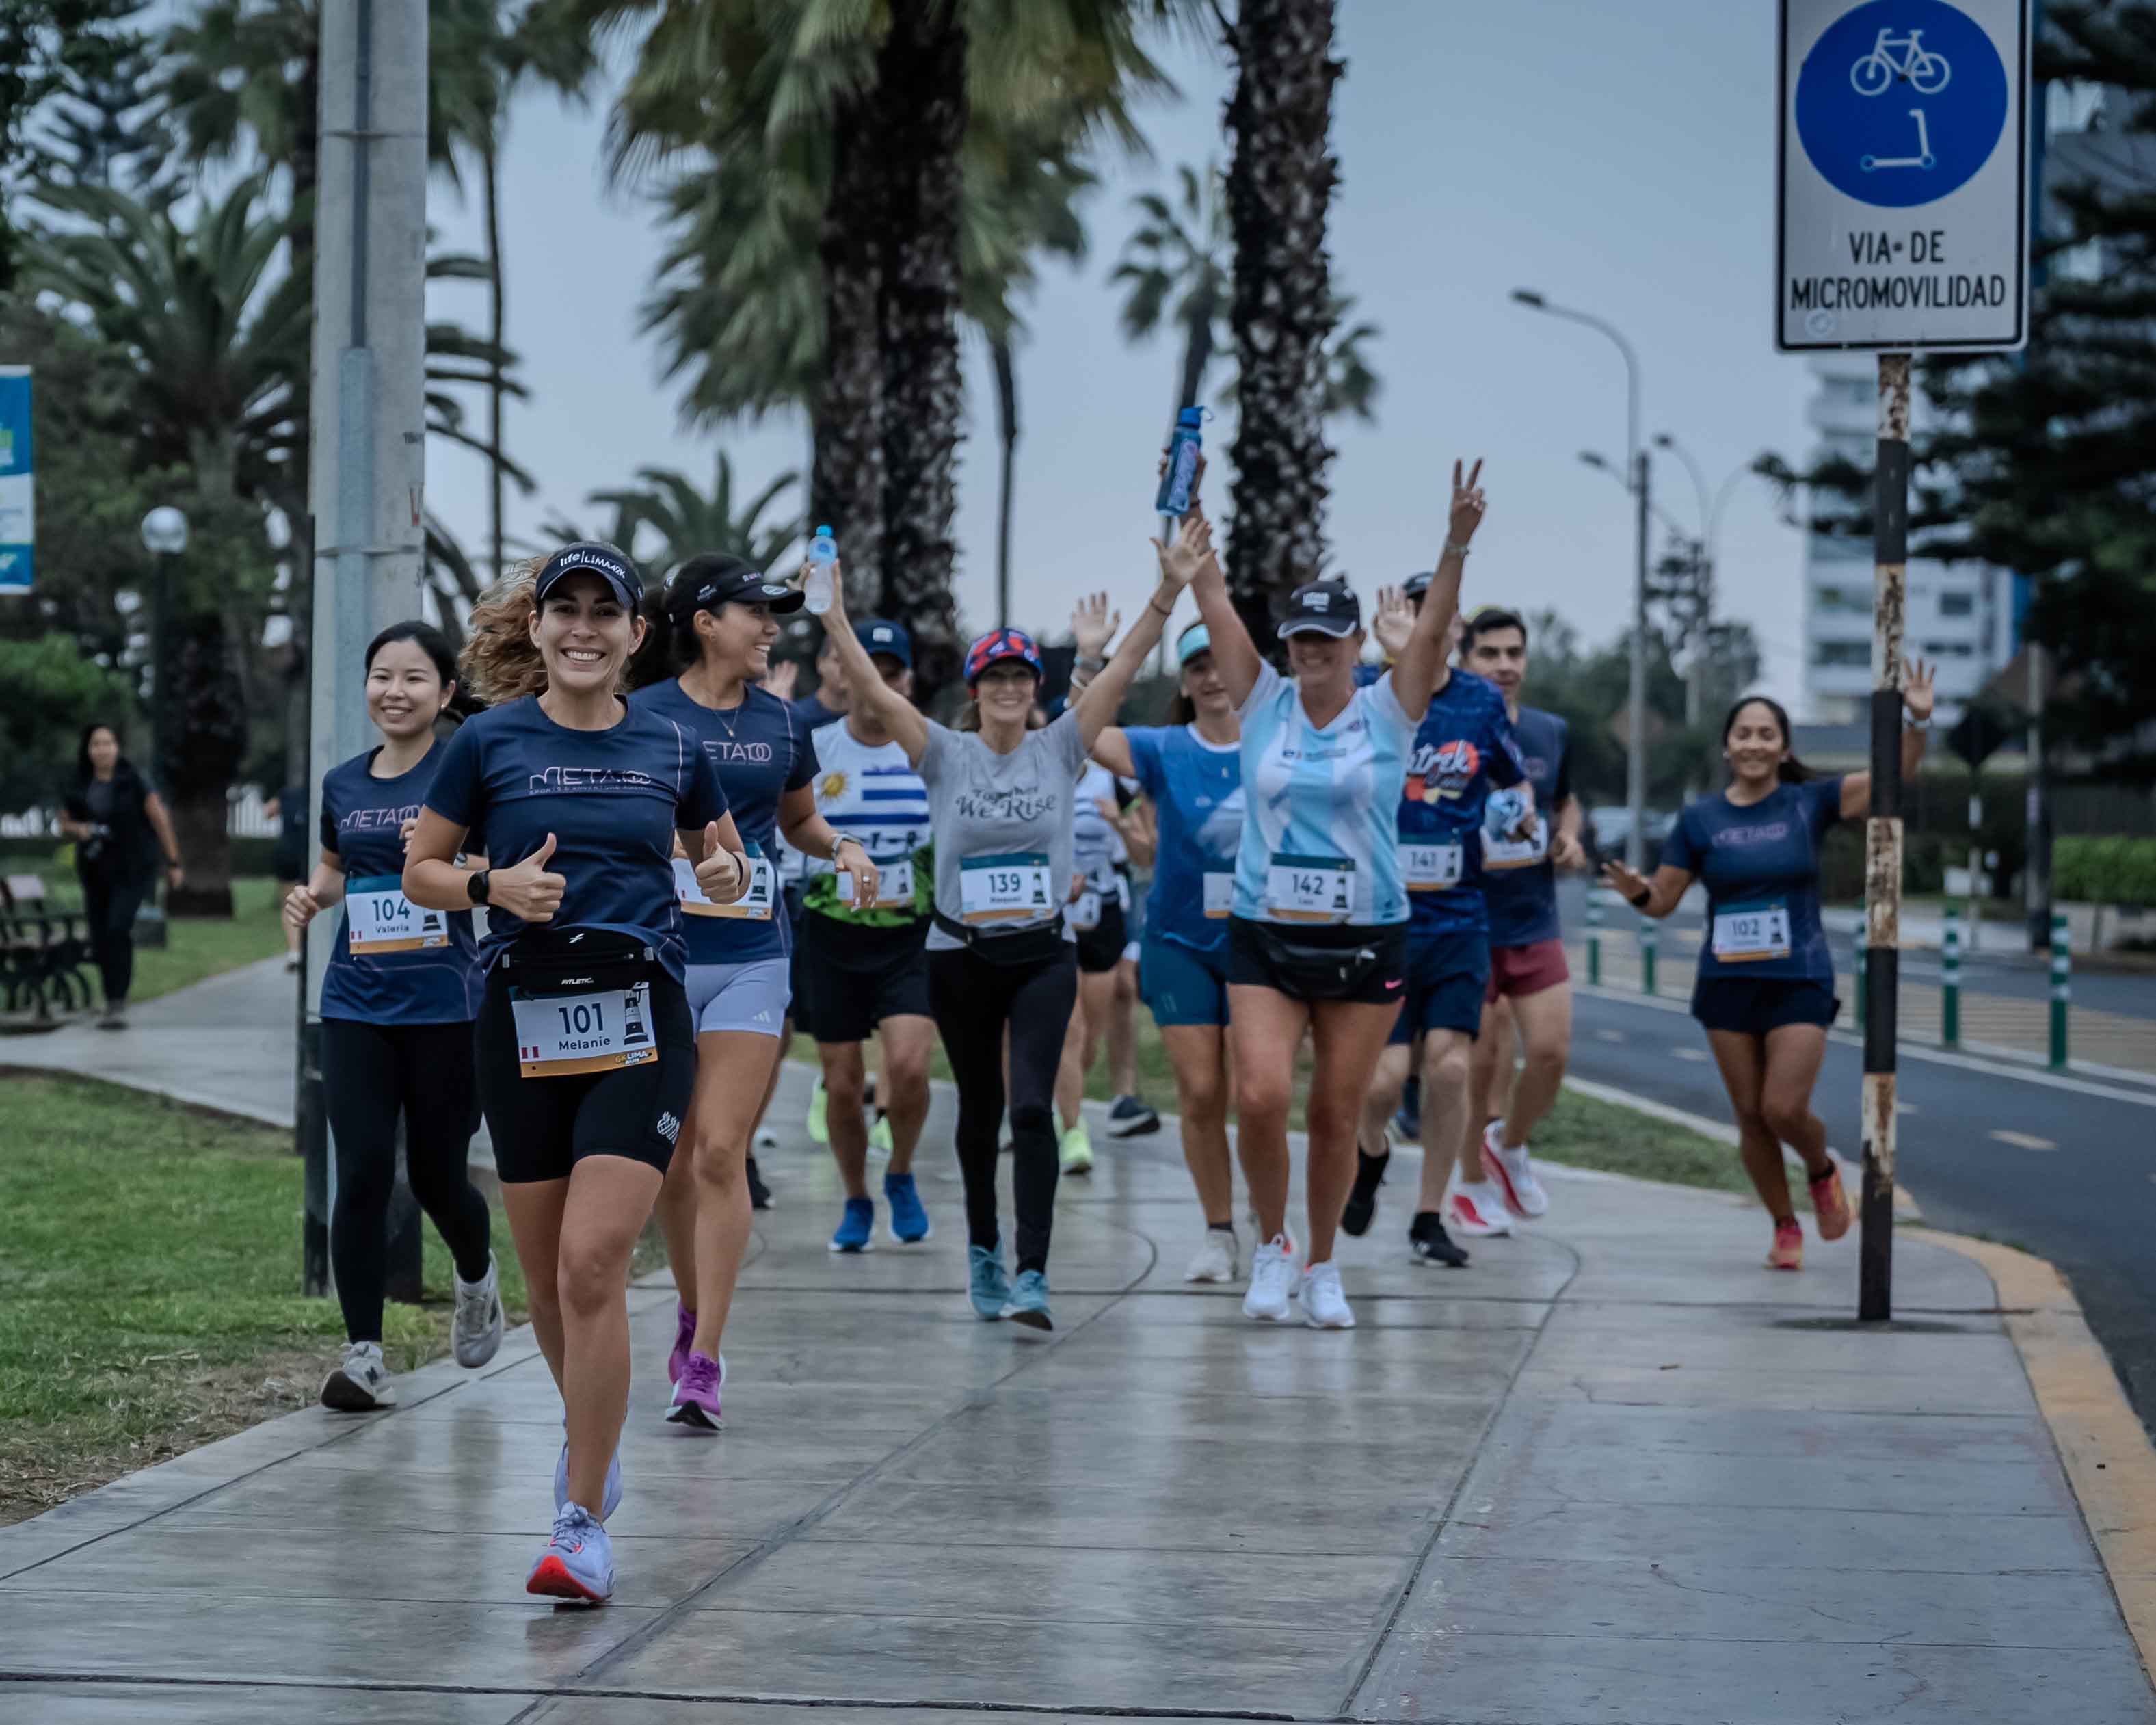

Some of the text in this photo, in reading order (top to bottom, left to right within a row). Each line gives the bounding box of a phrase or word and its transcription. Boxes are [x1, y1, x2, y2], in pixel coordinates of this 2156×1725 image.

[1848, 230, 1945, 264] VIA DE
[1790, 274, 2005, 310] MICROMOVILIDAD
[955, 795, 991, 818] We
[1411, 851, 1437, 867] 141
[988, 873, 1021, 893] 139
[1292, 873, 1325, 895] 142
[372, 897, 411, 921] 104
[375, 924, 410, 934] Valeria
[1731, 918, 1761, 936] 102
[558, 1002, 604, 1035] 101
[559, 1036, 611, 1051] Melanie
[626, 1050, 649, 1059] LIMA
